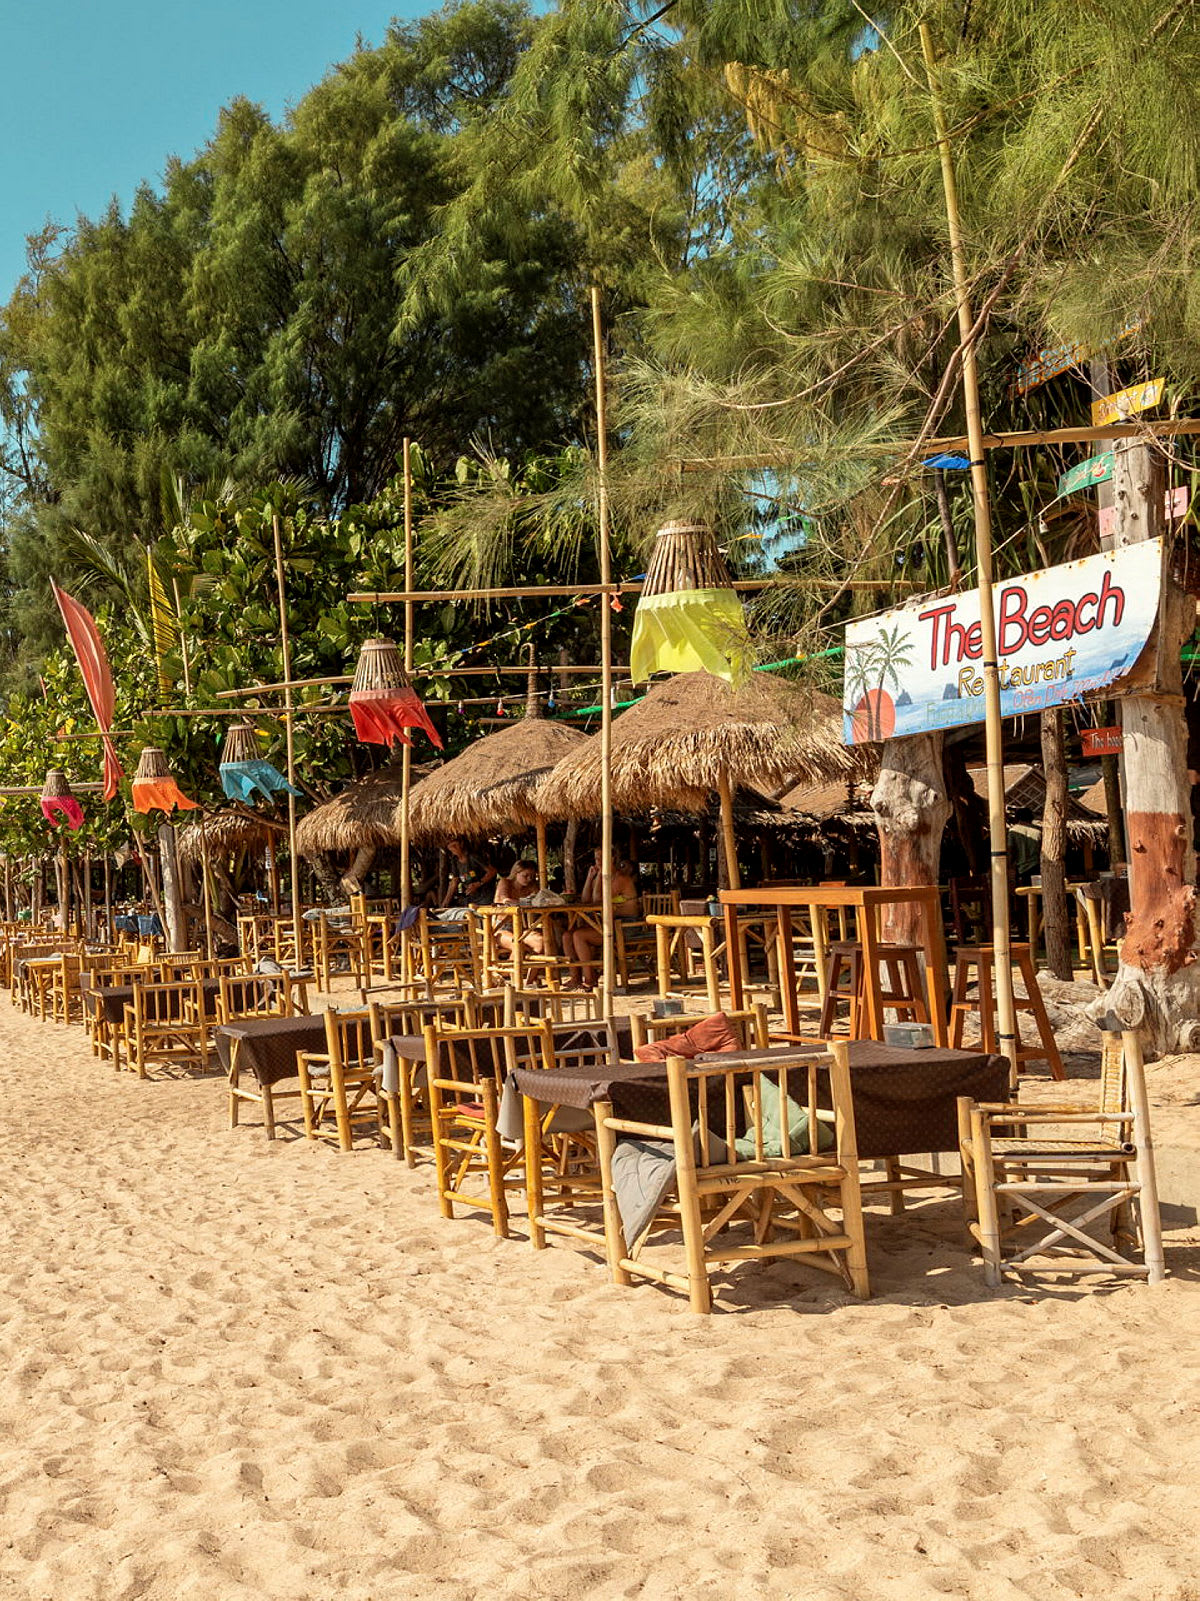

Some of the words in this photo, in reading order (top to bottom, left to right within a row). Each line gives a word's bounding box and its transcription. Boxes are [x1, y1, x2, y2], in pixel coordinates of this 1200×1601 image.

[918, 604, 982, 670] The
[998, 570, 1125, 656] Beach
[958, 646, 1077, 699] Retaurant
